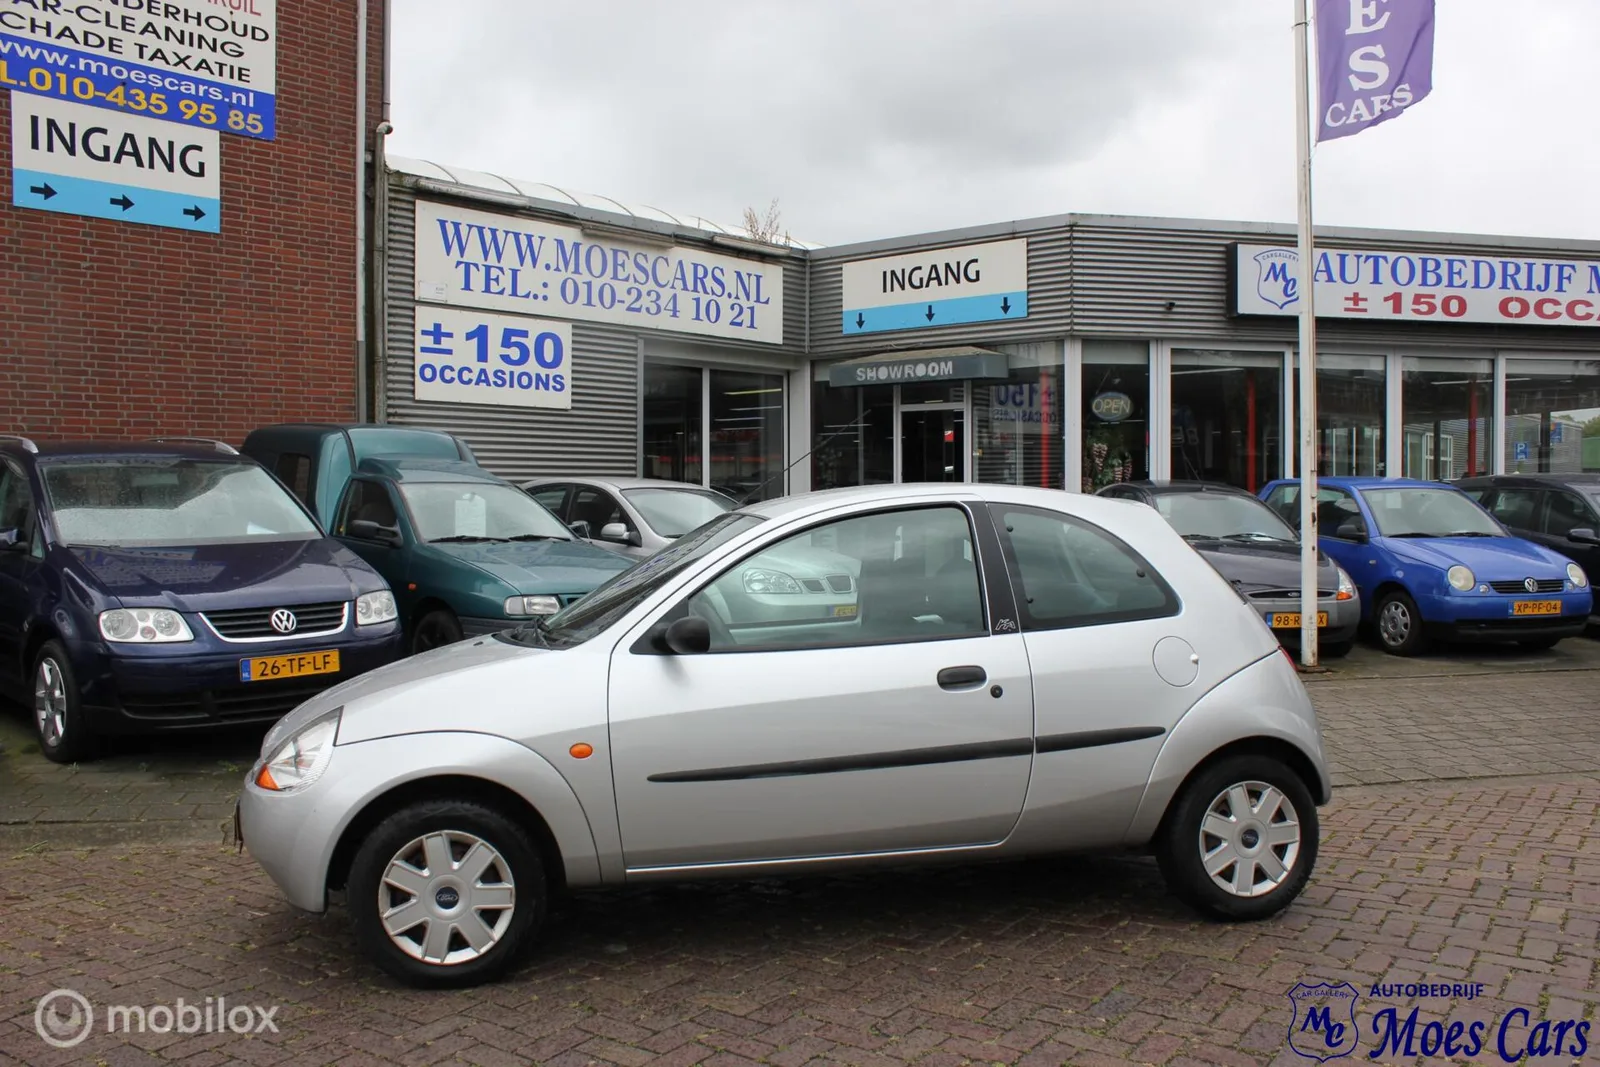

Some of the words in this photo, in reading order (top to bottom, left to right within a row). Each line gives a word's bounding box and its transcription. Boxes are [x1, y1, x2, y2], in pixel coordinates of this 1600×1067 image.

[134, 42, 251, 83] TAXATIE
[178, 99, 217, 125] 95
[227, 109, 264, 134] 85
[1325, 83, 1413, 127] CARS
[30, 114, 206, 178] INGANG
[436, 218, 770, 305] WWW.MOESCARS.NL
[882, 258, 981, 293] INGANG
[1314, 252, 1577, 293] AUTOBEDRIJF
[455, 260, 549, 301] TEL.:
[560, 277, 680, 318] 010-234
[690, 297, 721, 324] 10
[729, 303, 758, 330] 21
[1498, 296, 1600, 321] OCC
[419, 363, 565, 392] OCCASIONS
[856, 361, 953, 381] SHOWROOM
[1092, 399, 1131, 414] OPEN
[1275, 614, 1325, 626] 98-RX
[258, 654, 331, 677] 26-TF-LF
